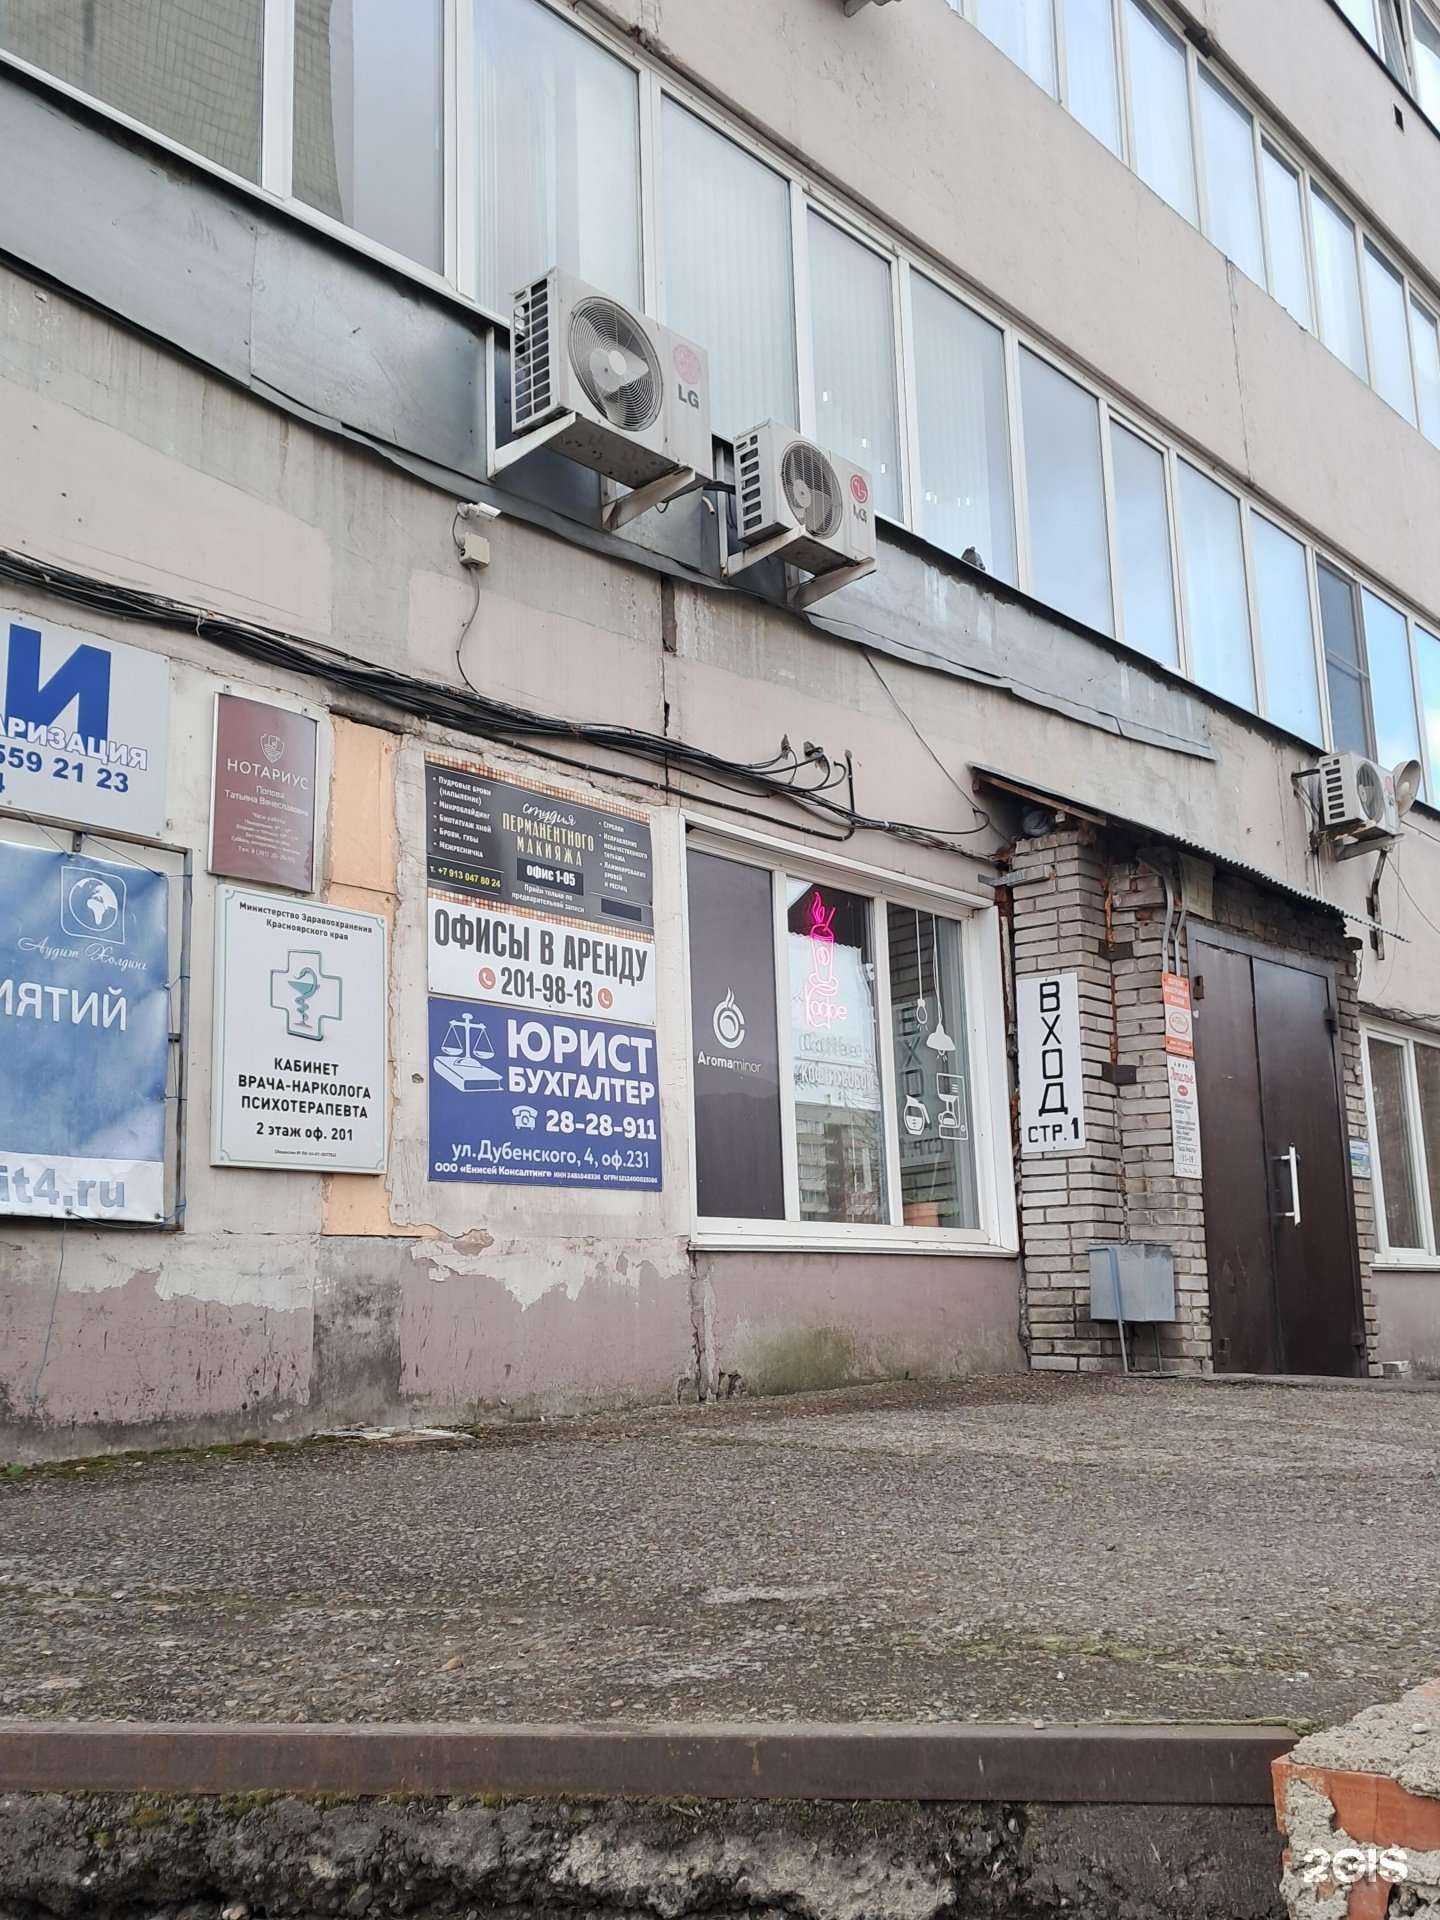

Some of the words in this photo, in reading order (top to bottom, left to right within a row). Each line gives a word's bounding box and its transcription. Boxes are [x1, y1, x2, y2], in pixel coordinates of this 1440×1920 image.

[678, 384, 699, 409] LG
[4, 623, 112, 752] И
[53, 757, 83, 783] 21
[96, 767, 129, 793] 23
[227, 757, 309, 791] НОТАРИУС
[522, 802, 577, 826] студия
[502, 812, 594, 852] ПЕРМАНЕНТНОГО
[516, 836, 583, 867] МАКИЯЖА
[438, 867, 448, 876] +7
[448, 868, 464, 880] 913
[526, 864, 554, 881] ОФИС
[555, 870, 576, 887] 1-05
[511, 892, 564, 909] предварительной
[239, 901, 300, 921] Министерство
[301, 912, 373, 934] Здравоохранения
[266, 918, 328, 938] Красноярского
[329, 931, 349, 942] края
[18, 935, 80, 961] Аудит
[434, 908, 530, 962] ОФИСЫ
[540, 929, 554, 966] В
[563, 934, 648, 987] АРЕНДУ
[501, 966, 593, 1009] 201-98-13
[507, 1018, 653, 1075] ЮРИСТ
[1038, 981, 1069, 1117] ВХОД
[273, 1056, 339, 1077] КАБИНЕТ
[697, 1050, 762, 1074] Aromaminor
[238, 1073, 371, 1100] ВРАЧА-НАРКОЛОГА
[508, 1065, 655, 1106] БУХГАЛТЕР
[241, 1095, 368, 1119] ПСИХОТЕРАПЕВТА
[256, 1121, 264, 1135] 2
[268, 1125, 301, 1138] этаж
[305, 1126, 328, 1142] оф.
[331, 1127, 353, 1142] 201
[545, 1109, 657, 1141] 28-28-911
[434, 1162, 458, 1174] ООО
[459, 1165, 498, 1177] «Енисей
[498, 1165, 552, 1179] Консалтинг»
